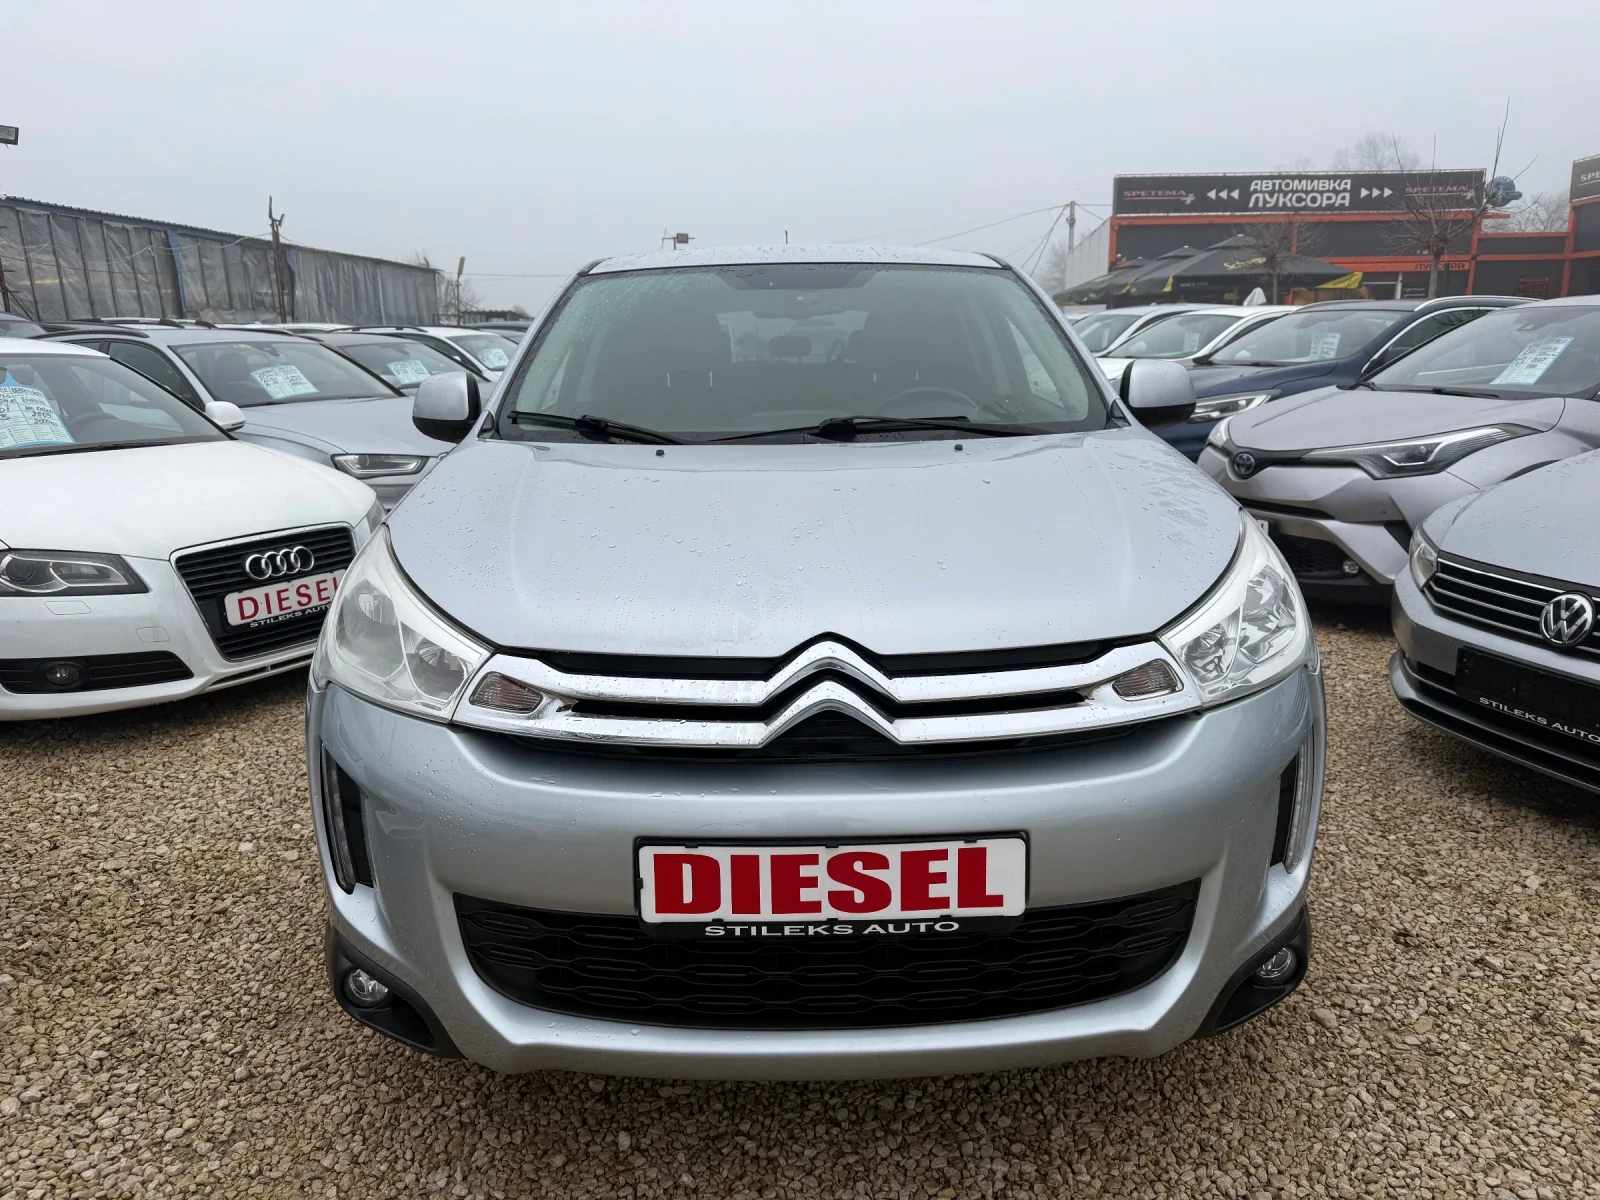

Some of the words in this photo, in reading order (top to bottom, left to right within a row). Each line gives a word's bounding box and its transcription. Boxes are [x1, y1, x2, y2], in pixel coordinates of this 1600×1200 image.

[1123, 189, 1187, 197] SPETEMA
[1249, 179, 1352, 191] АВТОМИВКА
[1248, 192, 1351, 208] ЛУКСОРА
[249, 611, 302, 628] STILEKS
[1479, 696, 1548, 725] STILEKS
[1551, 722, 1600, 742] AUTO
[653, 847, 1004, 915] DIESEL
[704, 924, 853, 937] STILEKS
[862, 921, 960, 935] AUTO
